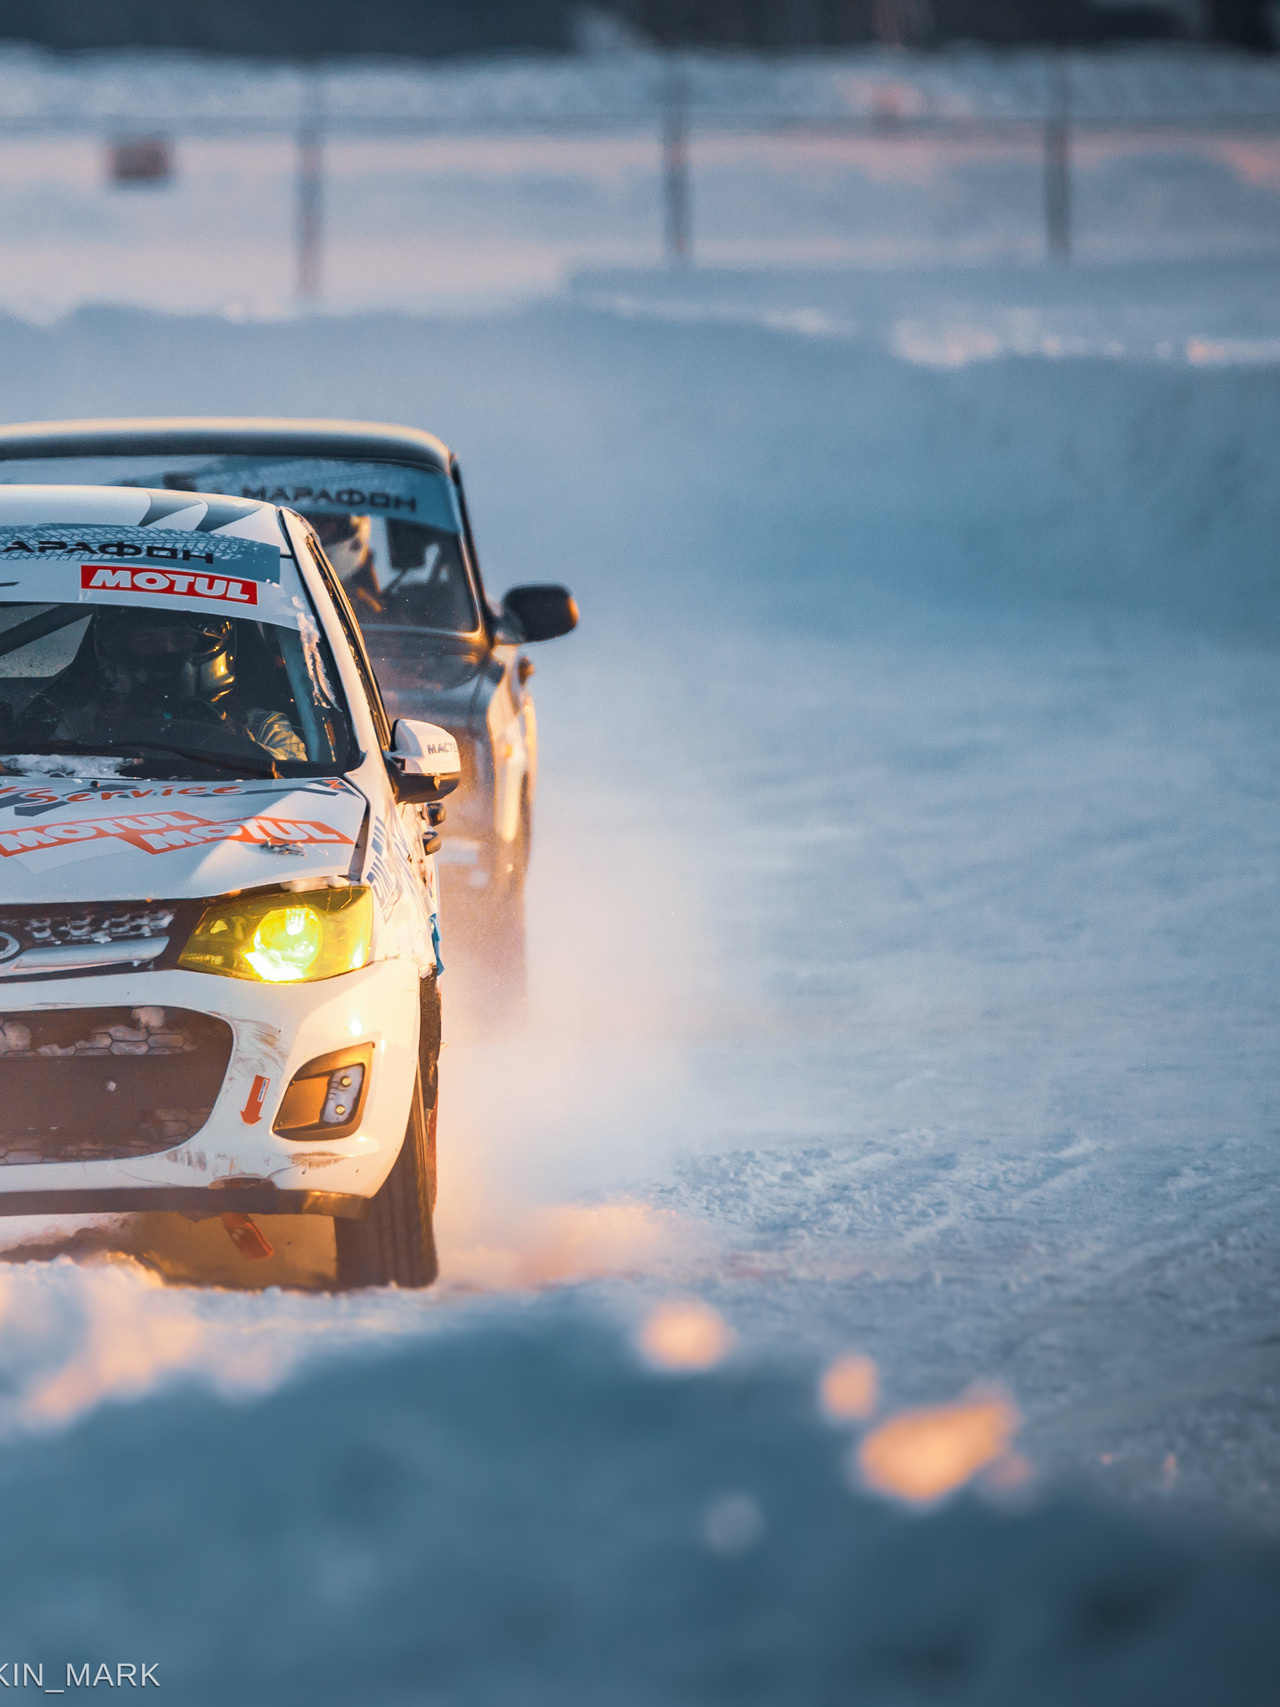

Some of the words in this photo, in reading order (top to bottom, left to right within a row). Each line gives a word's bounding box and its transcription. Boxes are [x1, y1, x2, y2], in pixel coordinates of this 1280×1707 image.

[241, 486, 418, 514] МАРАФОН
[88, 568, 251, 601] MOTUL
[138, 818, 341, 851] MOTUL
